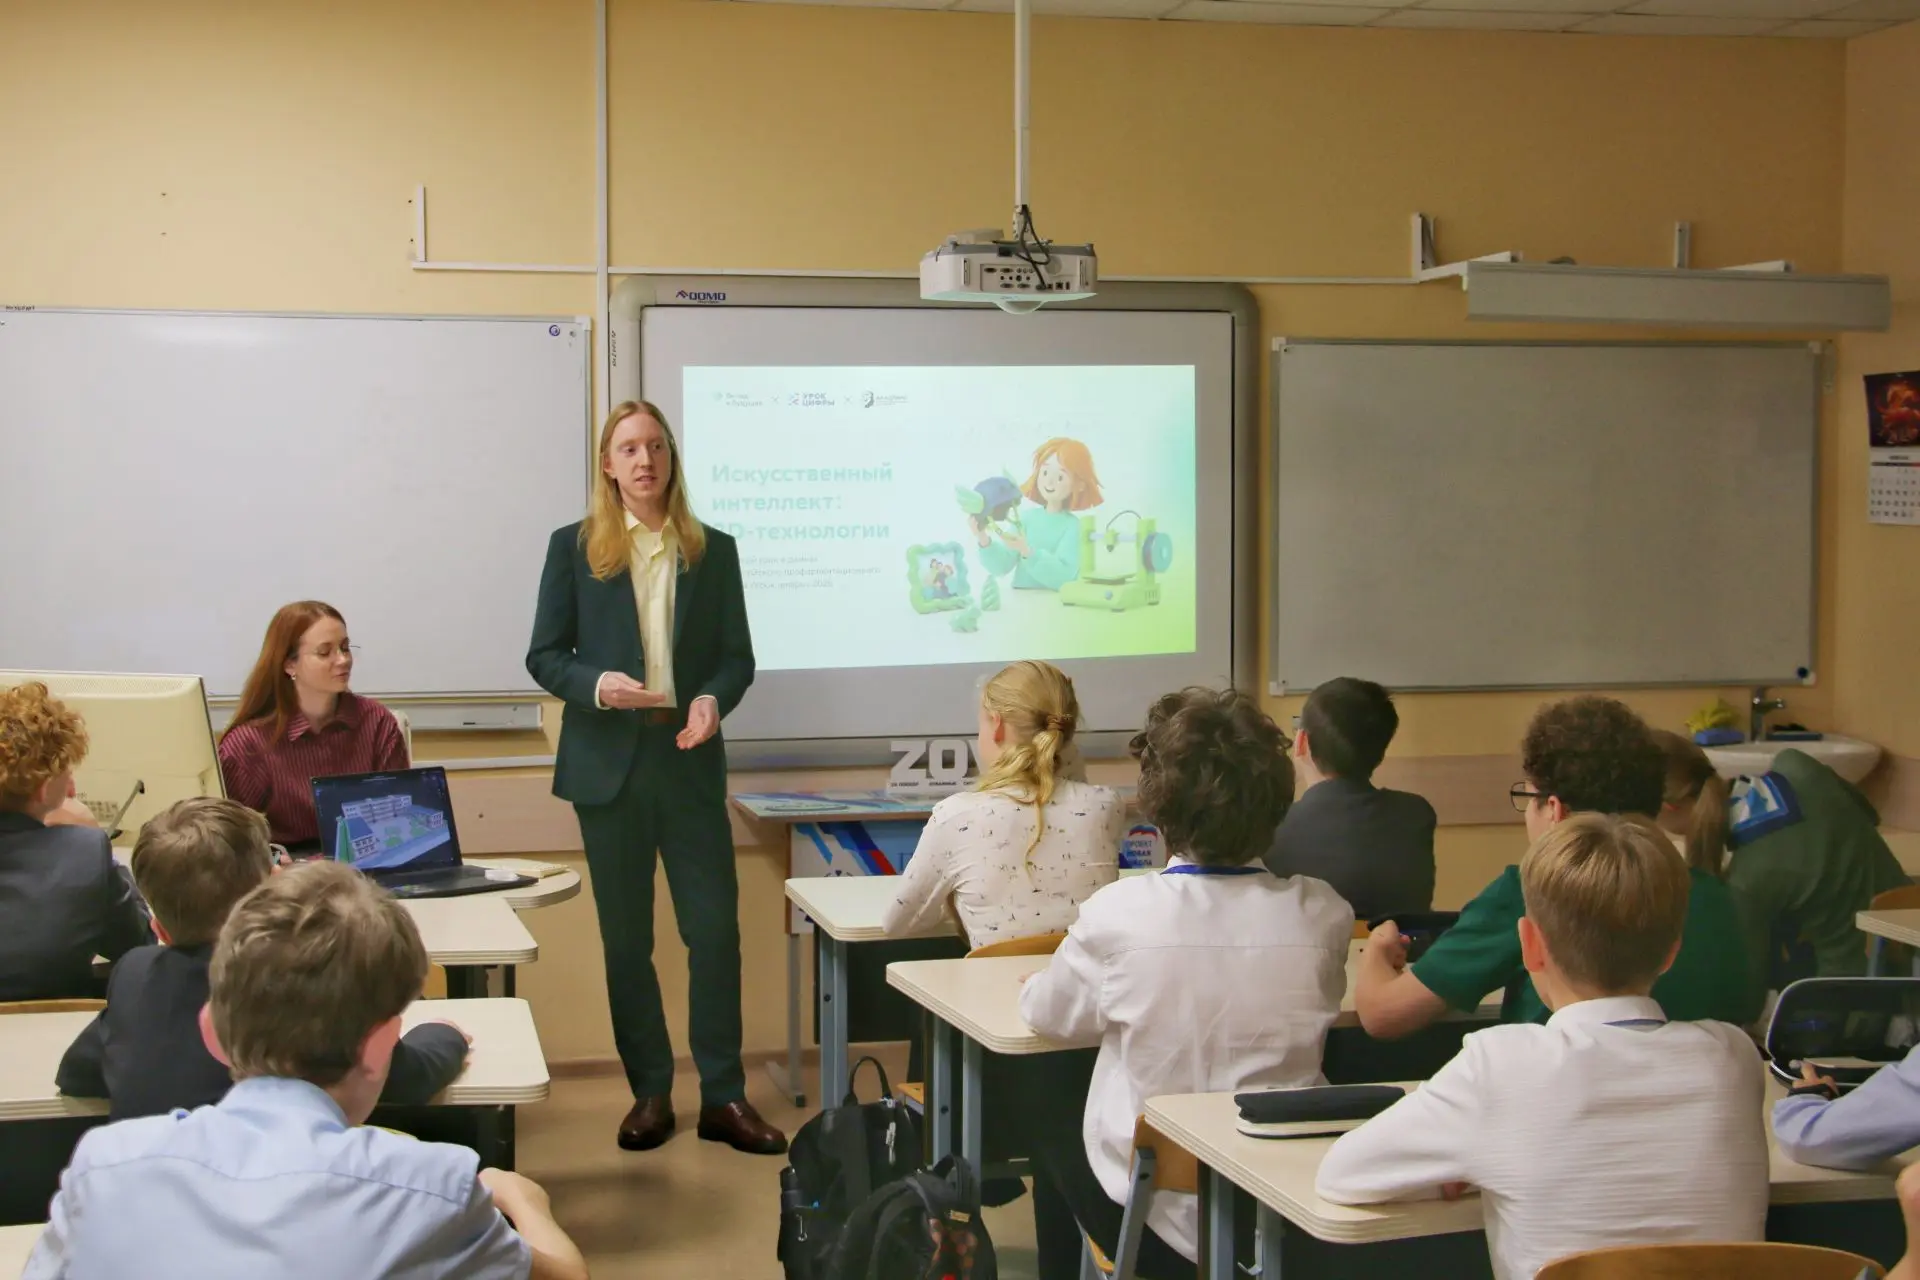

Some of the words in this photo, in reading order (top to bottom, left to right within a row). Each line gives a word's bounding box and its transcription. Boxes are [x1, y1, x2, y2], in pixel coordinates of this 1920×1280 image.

[803, 392, 826, 400] УРОК
[802, 399, 835, 408] ЦИФРЫ
[711, 461, 893, 486] Искусственный
[712, 495, 842, 512] интеллект:
